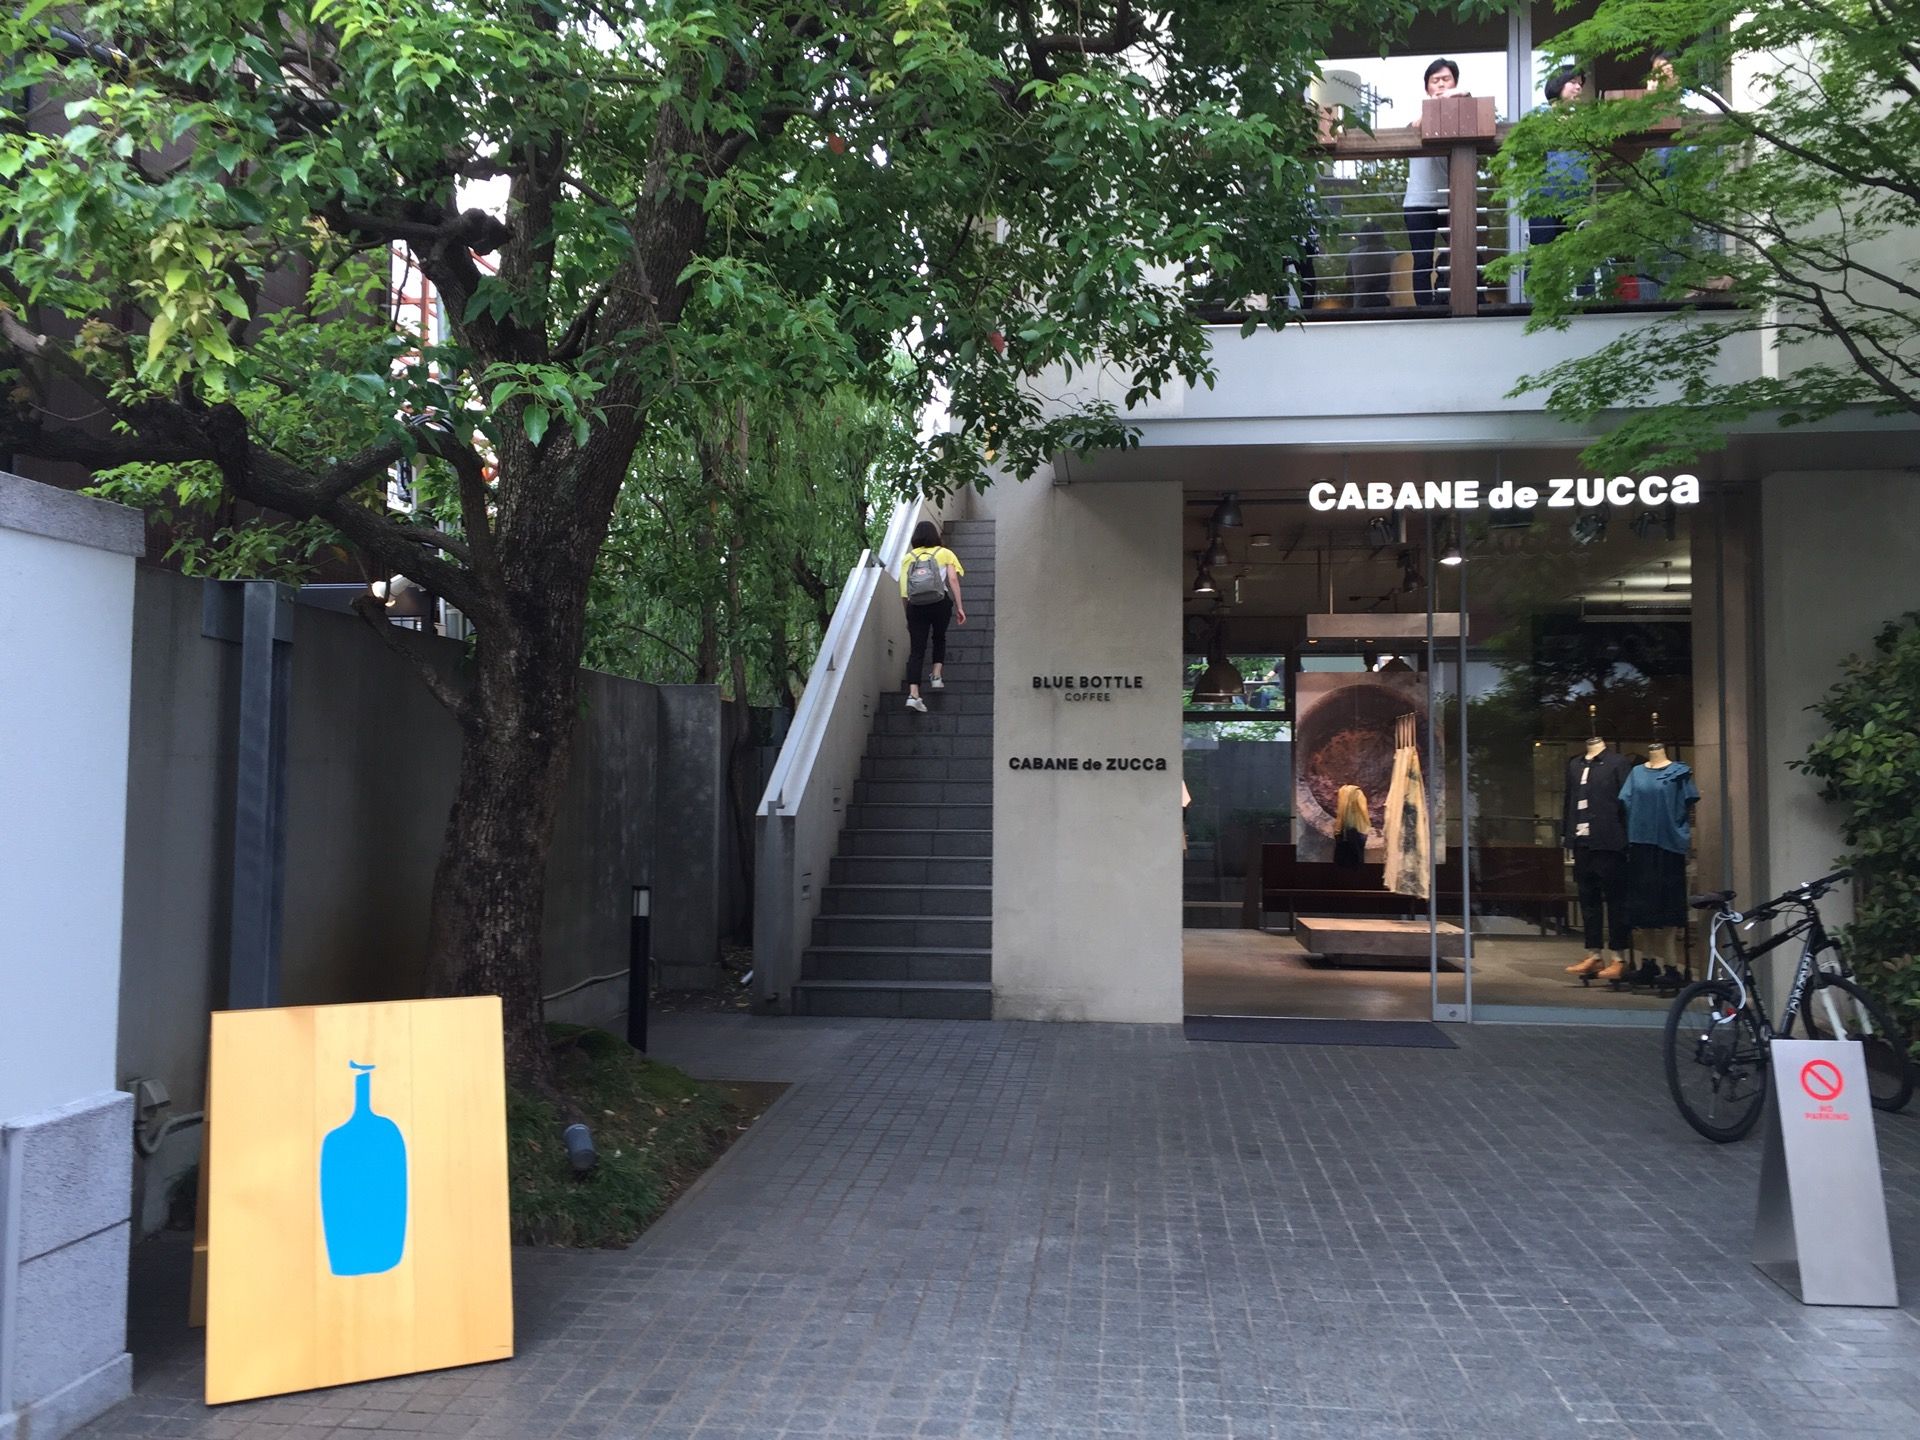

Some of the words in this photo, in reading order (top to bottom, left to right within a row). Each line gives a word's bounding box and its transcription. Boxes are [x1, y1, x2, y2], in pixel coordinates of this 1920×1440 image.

[1308, 480, 1479, 511] CABANE
[1487, 481, 1539, 510] de
[1032, 676, 1074, 689] BLUE
[1079, 676, 1143, 689] BOTTLE
[1064, 692, 1111, 702] COFFEE
[1009, 757, 1078, 771] CABANE
[1082, 758, 1102, 771] de
